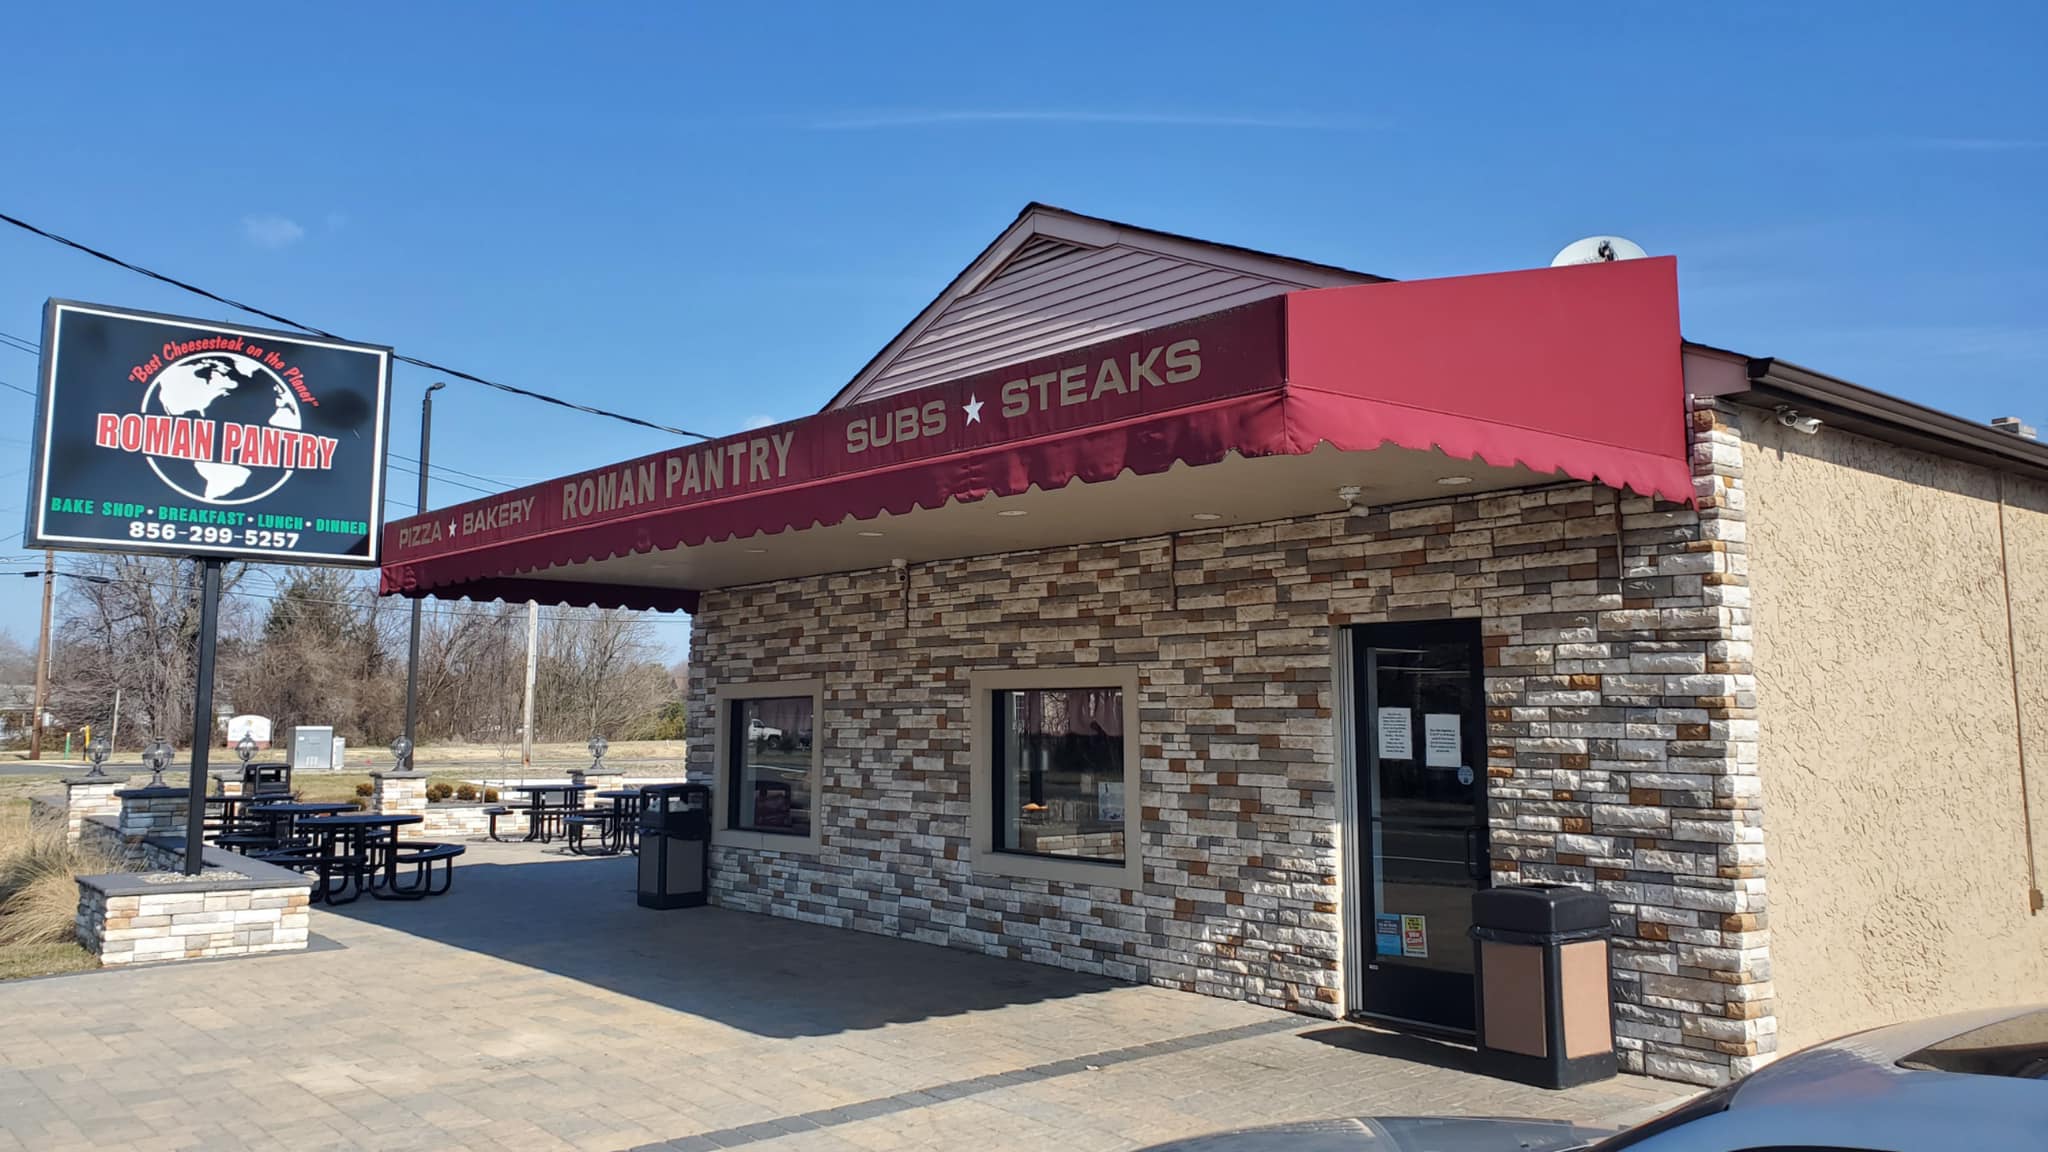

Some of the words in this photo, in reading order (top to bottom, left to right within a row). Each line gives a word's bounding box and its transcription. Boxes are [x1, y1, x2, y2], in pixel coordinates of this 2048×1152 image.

[162, 336, 244, 361] Cheesesteak
[246, 344, 264, 358] on
[264, 351, 286, 370] the
[846, 400, 948, 454] SUBS
[1001, 338, 1202, 419] STEAKS
[96, 412, 216, 463] ROMAN
[222, 421, 339, 470] PANTRY
[562, 462, 657, 521] ROMAN
[665, 431, 795, 499] PANTRY
[50, 497, 94, 515] BAKE
[102, 501, 145, 520] SHOP
[158, 506, 245, 527] BREAKFAST
[257, 513, 304, 531] LUNCH
[315, 518, 368, 536] DINNER
[129, 521, 300, 548] 856-299-5257
[399, 520, 442, 550] PIZZA
[462, 496, 536, 536] BAKERY
